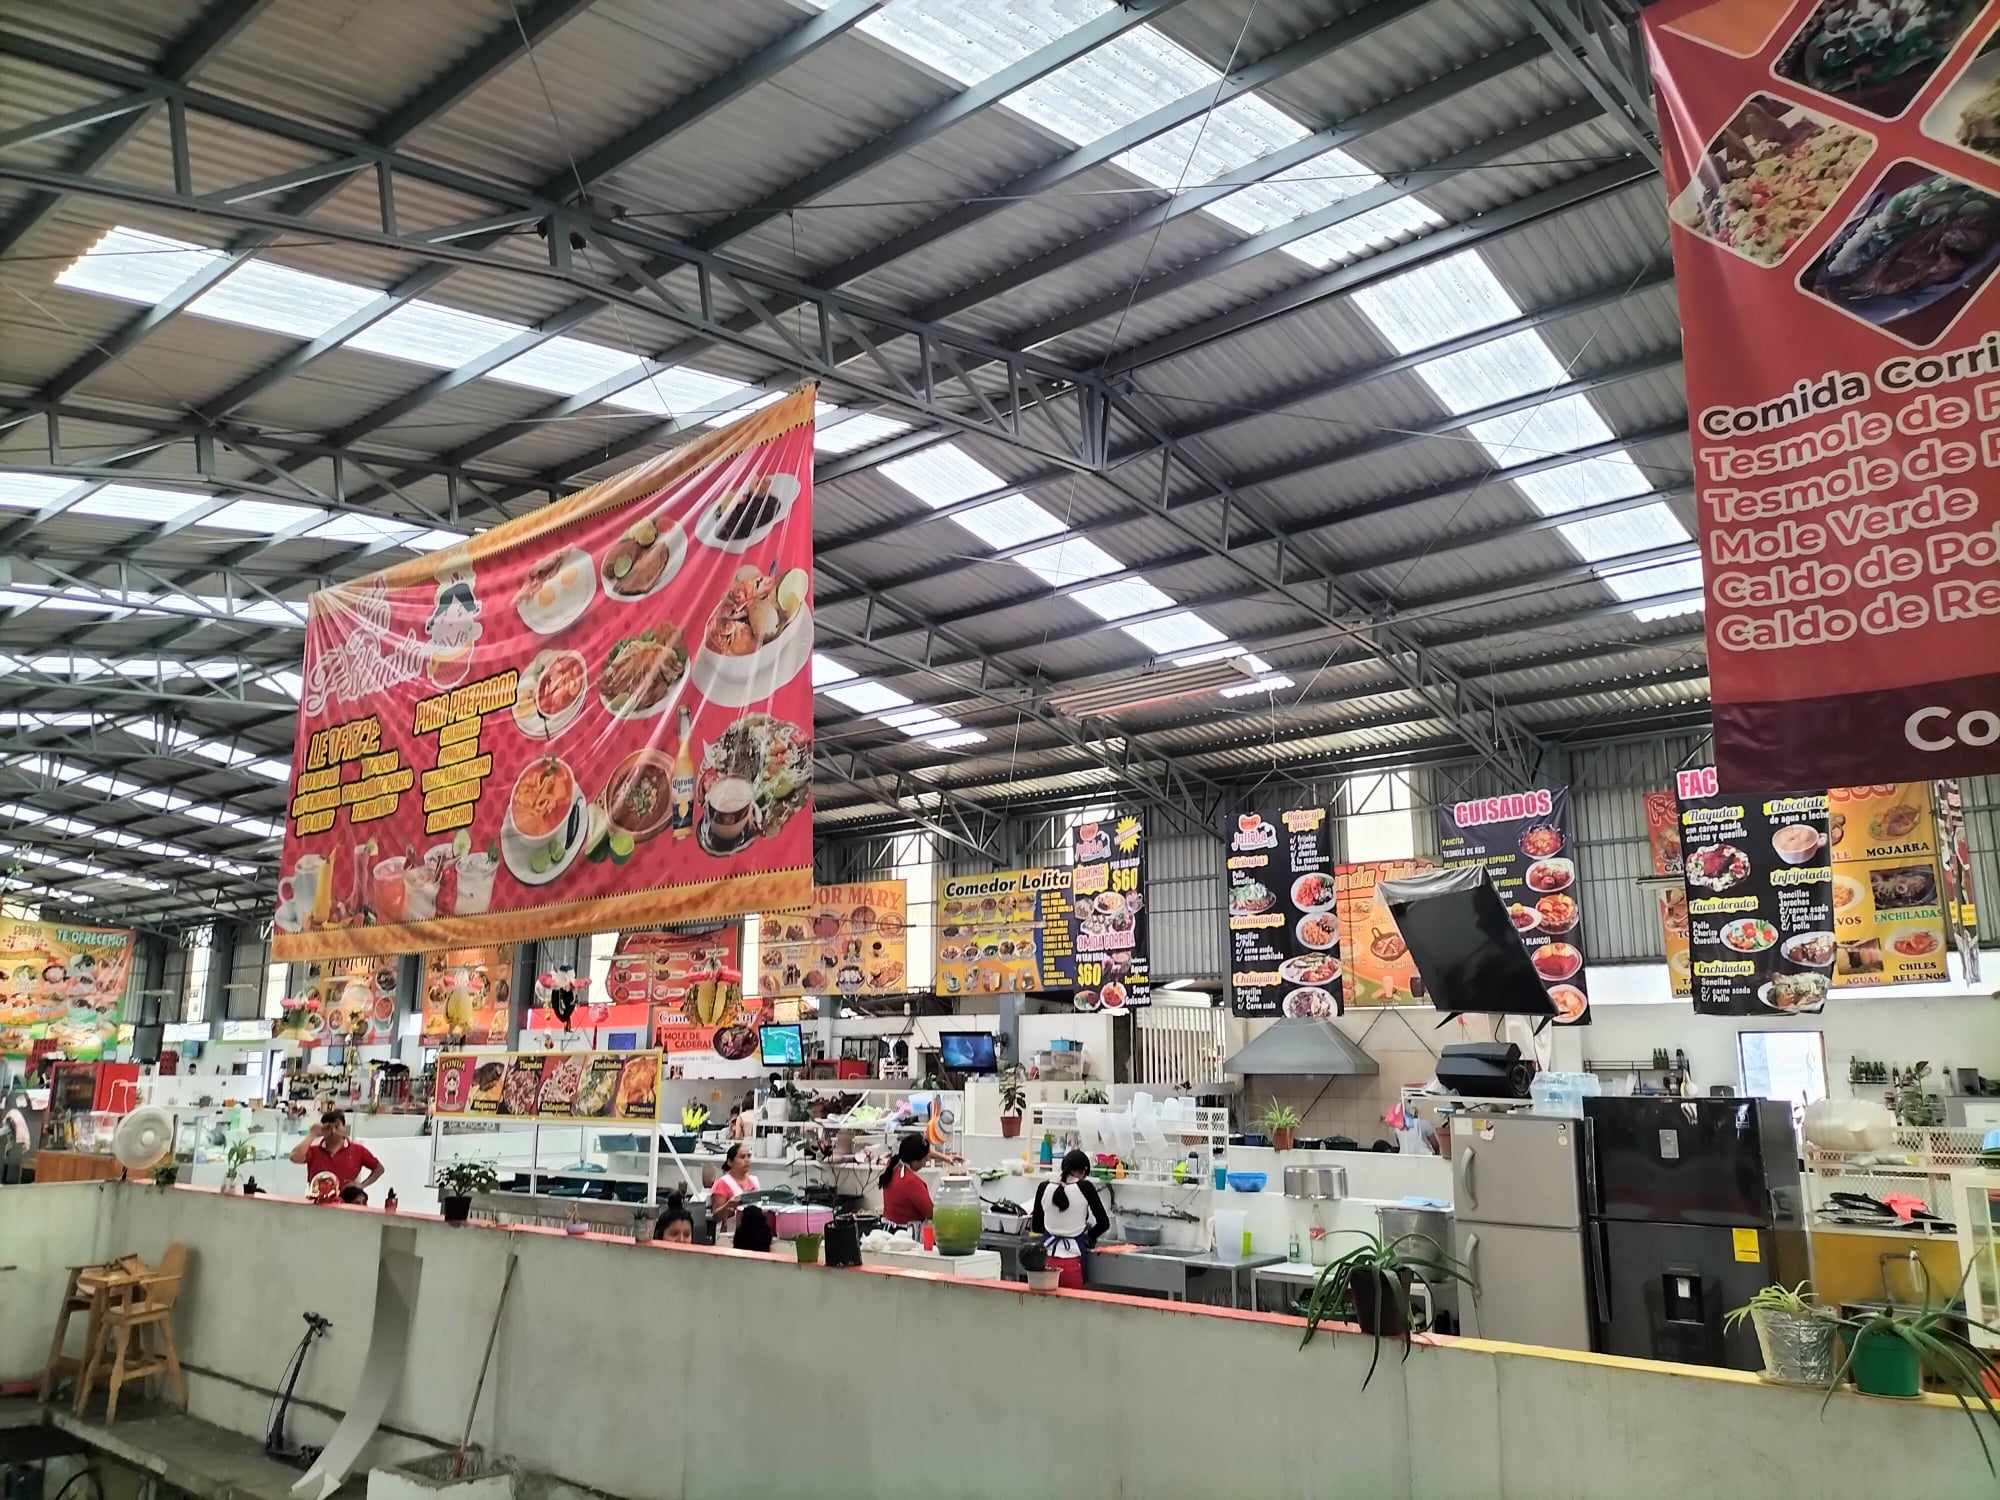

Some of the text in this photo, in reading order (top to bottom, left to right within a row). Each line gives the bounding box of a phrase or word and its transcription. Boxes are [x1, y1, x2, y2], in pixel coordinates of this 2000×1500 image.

[1701, 334, 2000, 438] Comida Corri
[1703, 412, 1891, 480] Tesmole
[1899, 397, 1968, 435] de
[1706, 456, 1898, 522] Tesmole
[1904, 441, 1975, 481] de
[1712, 487, 1979, 564] Mole Verde
[1716, 564, 1851, 608] Caldo
[1856, 546, 1922, 582] de
[1717, 605, 1859, 651] Caldo
[1861, 590, 1930, 635] de
[1679, 767, 1718, 799] FAC
[1455, 791, 1551, 825] GUISADOS
[1866, 842, 1930, 857] MOJARRA
[945, 870, 1071, 898] Comedor Lolita
[1112, 868, 1138, 892] $60
[1772, 868, 1832, 885] Enfrijolada
[848, 885, 902, 910] MARY
[1874, 909, 1944, 921] ENCHILADAS
[1077, 963, 1102, 986] $60
[1899, 961, 1937, 971] CHILES
